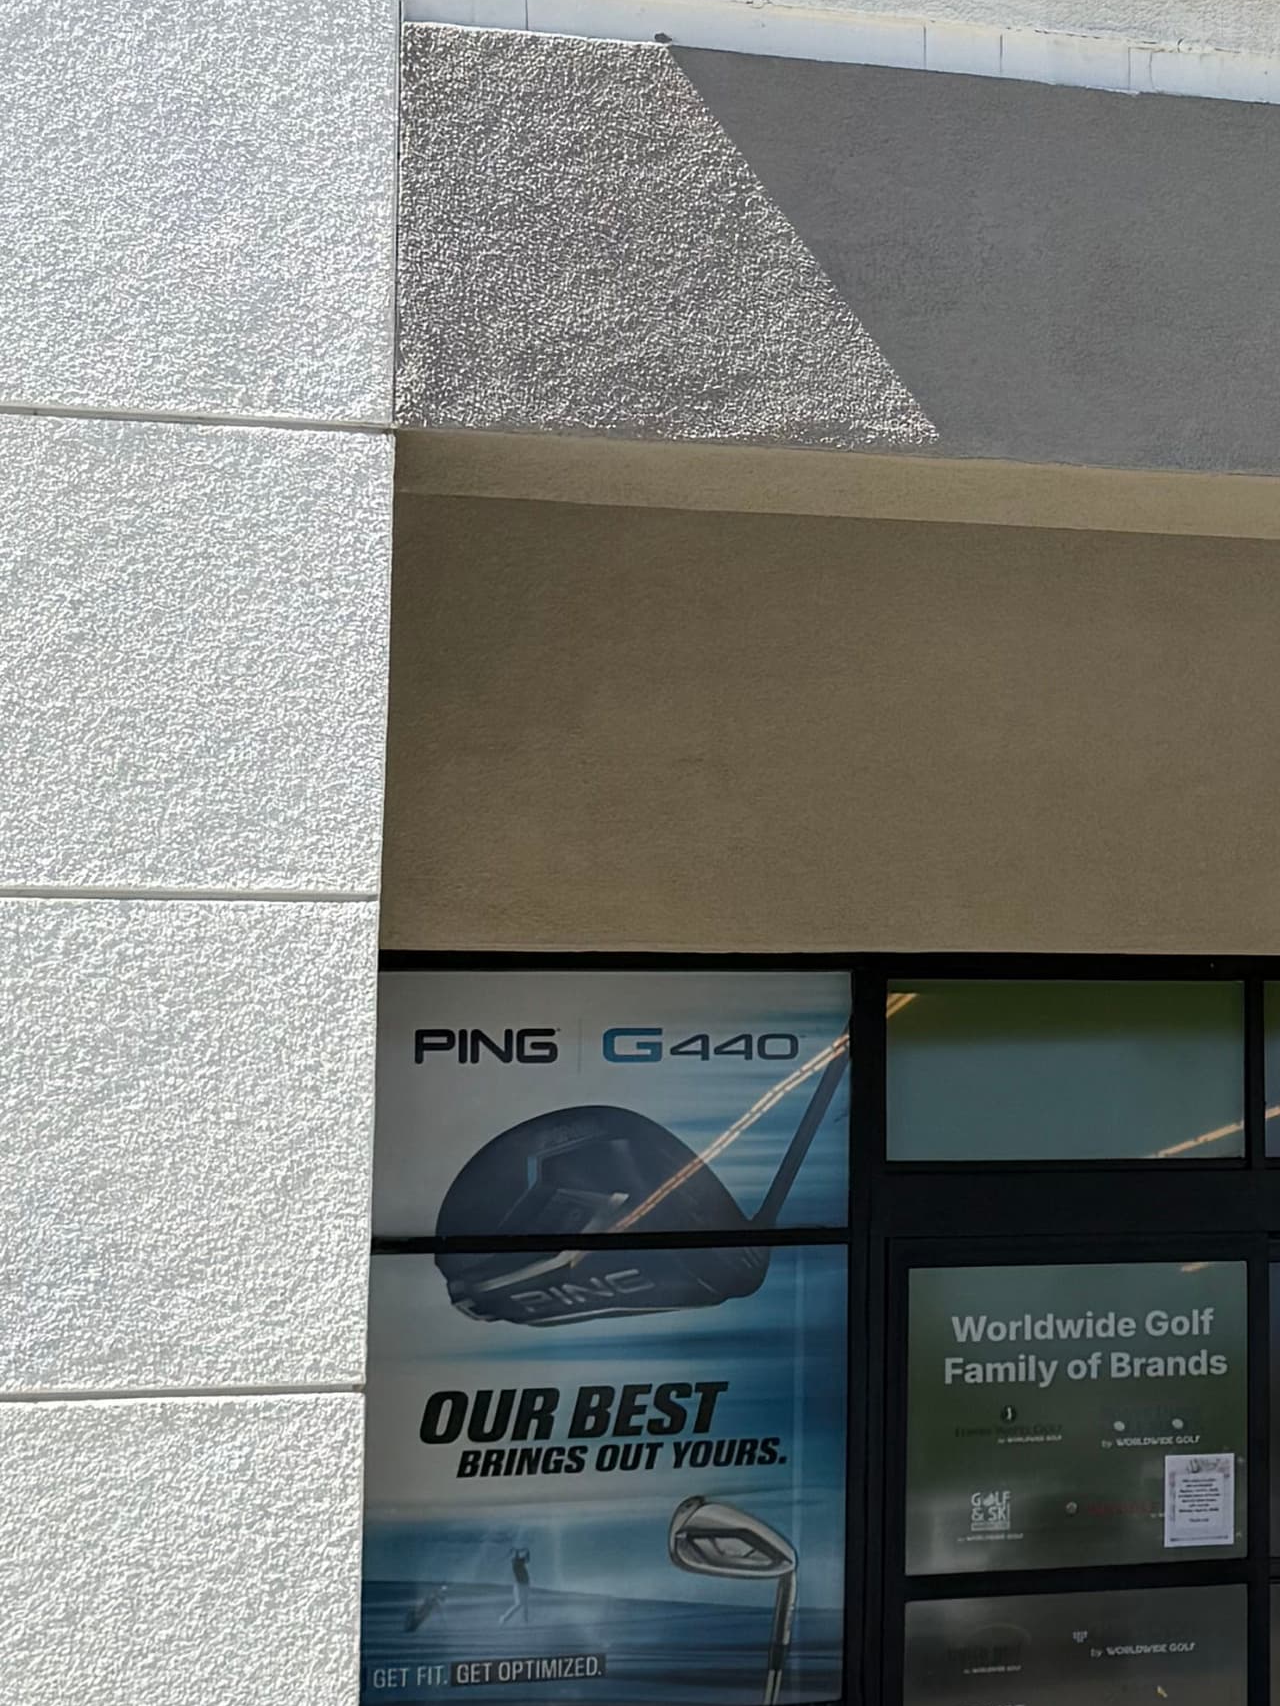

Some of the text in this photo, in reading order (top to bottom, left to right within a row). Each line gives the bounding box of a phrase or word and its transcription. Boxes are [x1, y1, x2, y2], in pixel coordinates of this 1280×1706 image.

[414, 1028, 559, 1064] PING
[602, 1028, 799, 1063] G440
[951, 1307, 1215, 1343] Worldwide Golf
[943, 1349, 1229, 1389] Family of Brands
[419, 1381, 731, 1444] OUR BEST
[456, 1437, 788, 1478] BRINGS OUT YOURS.
[1115, 1435, 1174, 1447] WORLDWIDE
[1175, 1434, 1201, 1445] GOLF
[1105, 1644, 1167, 1655] WORLDWIDE
[1168, 1641, 1196, 1653] GOLF
[372, 1655, 603, 1689] GET FIT. GET OPTIMIZED.
